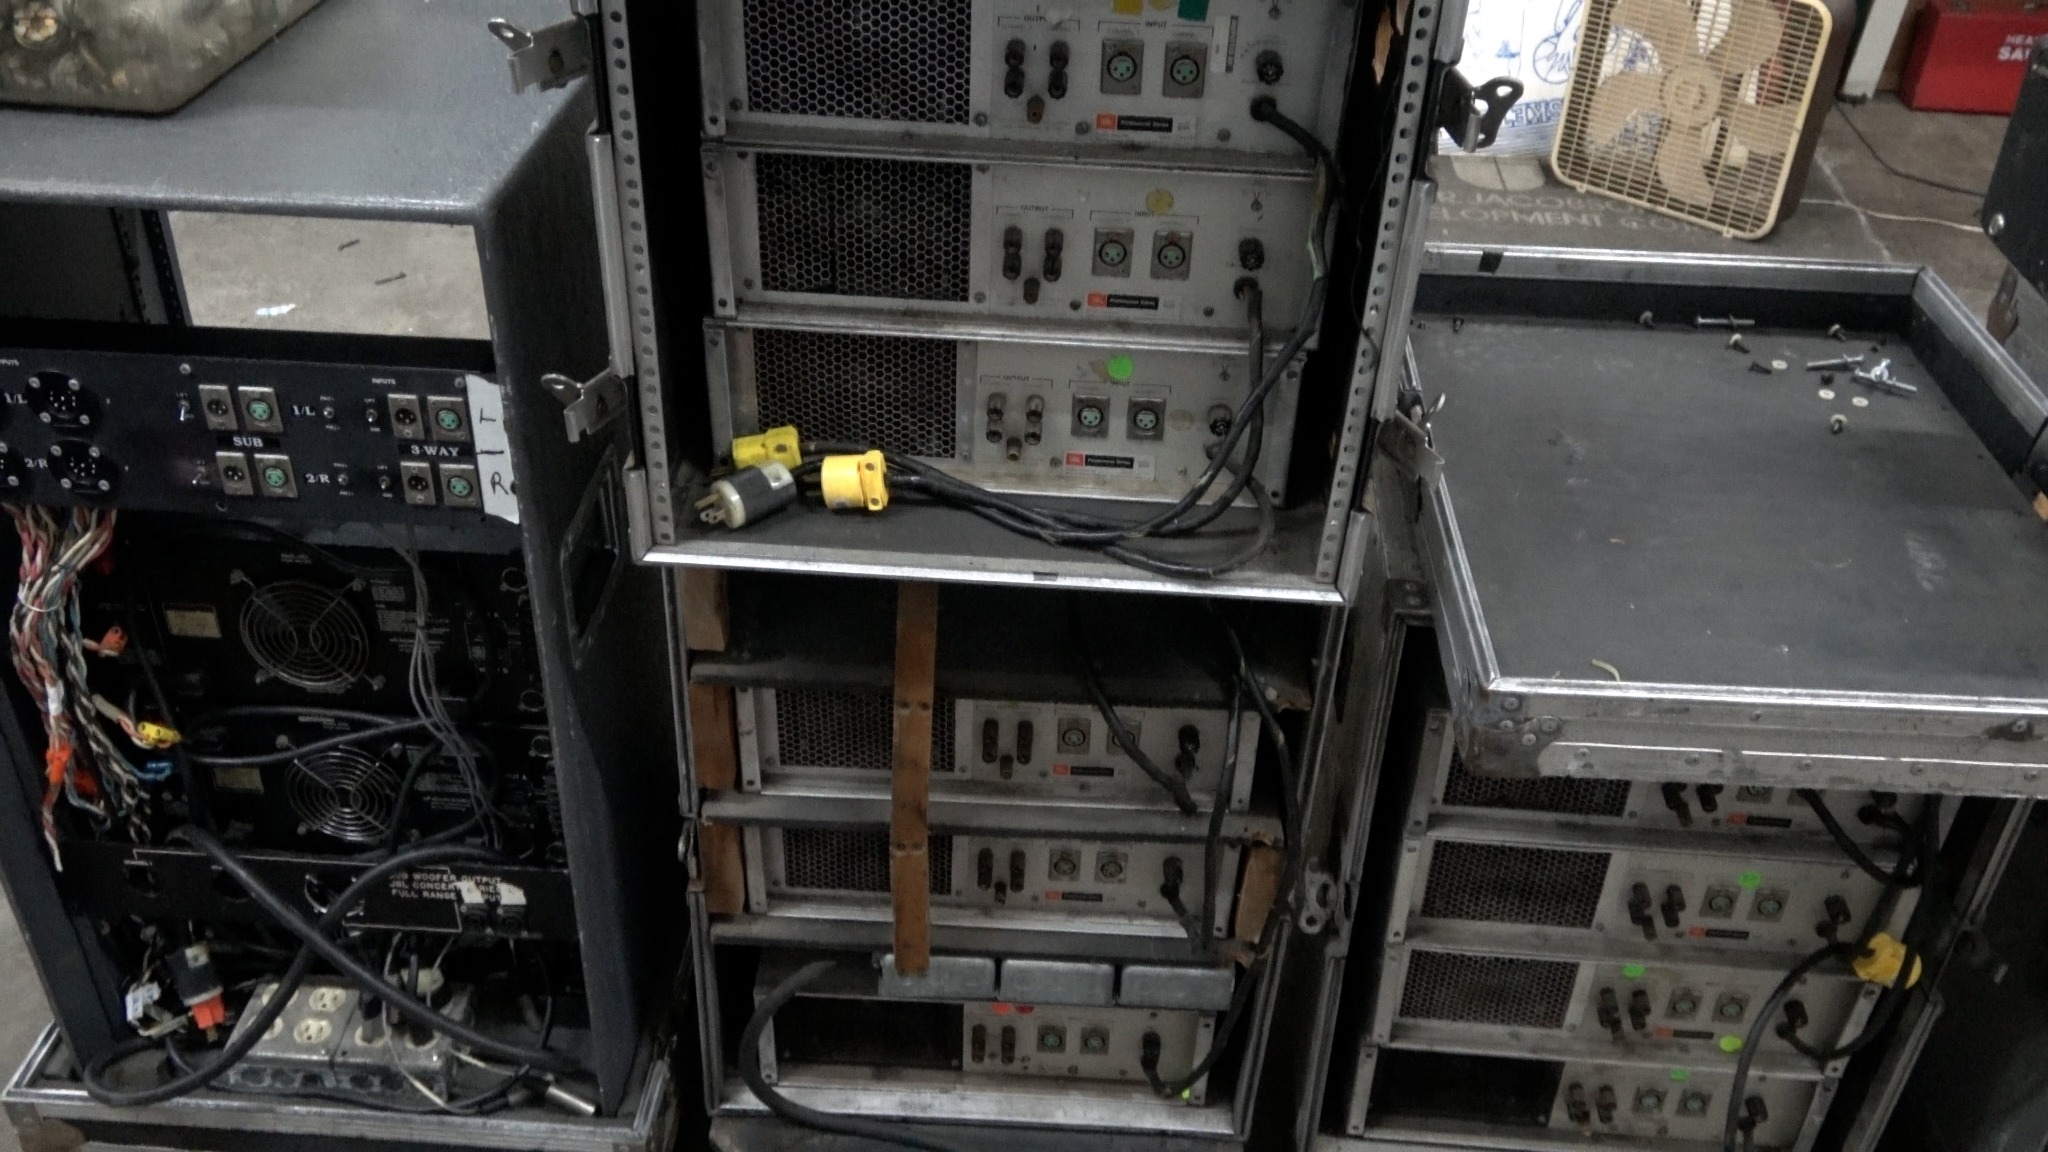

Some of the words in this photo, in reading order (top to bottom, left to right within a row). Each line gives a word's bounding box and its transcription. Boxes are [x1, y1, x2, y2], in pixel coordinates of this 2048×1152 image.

[292, 404, 316, 416] 1/L
[232, 436, 264, 448] SUB
[305, 473, 331, 484] 2/R
[490, 471, 509, 496] R
[412, 872, 457, 883] WOOFER
[391, 888, 419, 899] FULL
[422, 888, 457, 900] RANGE
